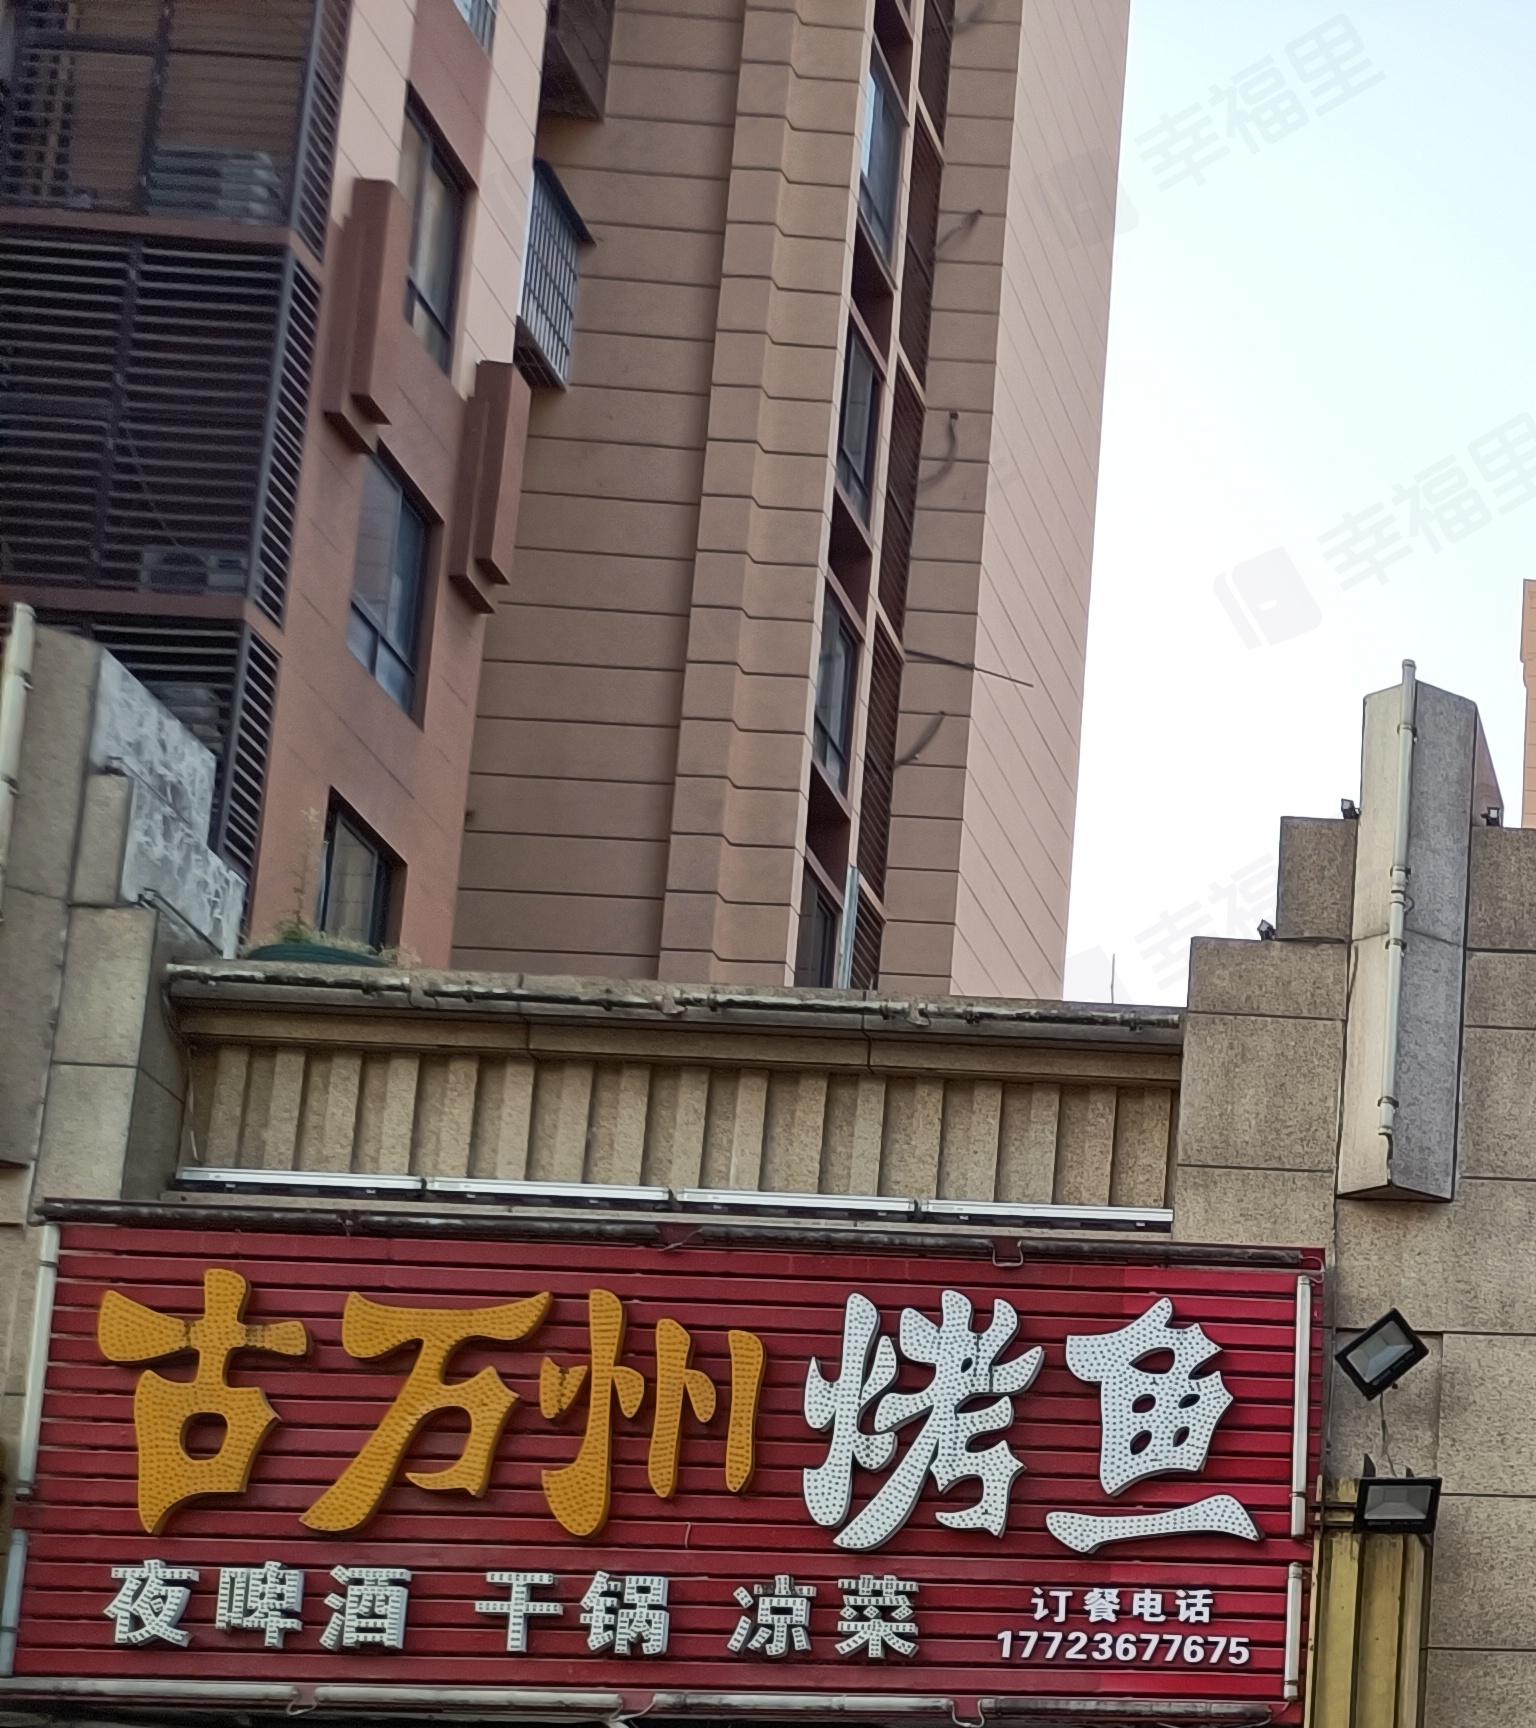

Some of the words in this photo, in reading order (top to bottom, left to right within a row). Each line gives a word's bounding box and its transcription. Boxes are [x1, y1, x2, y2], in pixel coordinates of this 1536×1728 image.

[96, 1268, 1260, 1556] 古万州烤鱼
[104, 1559, 411, 1650] 夜啤酒
[473, 1569, 671, 1658] 干锅
[727, 1574, 920, 1660] 凉菜
[1031, 1586, 1214, 1625] 订餐电话
[997, 1629, 1251, 1666] 17723677675
